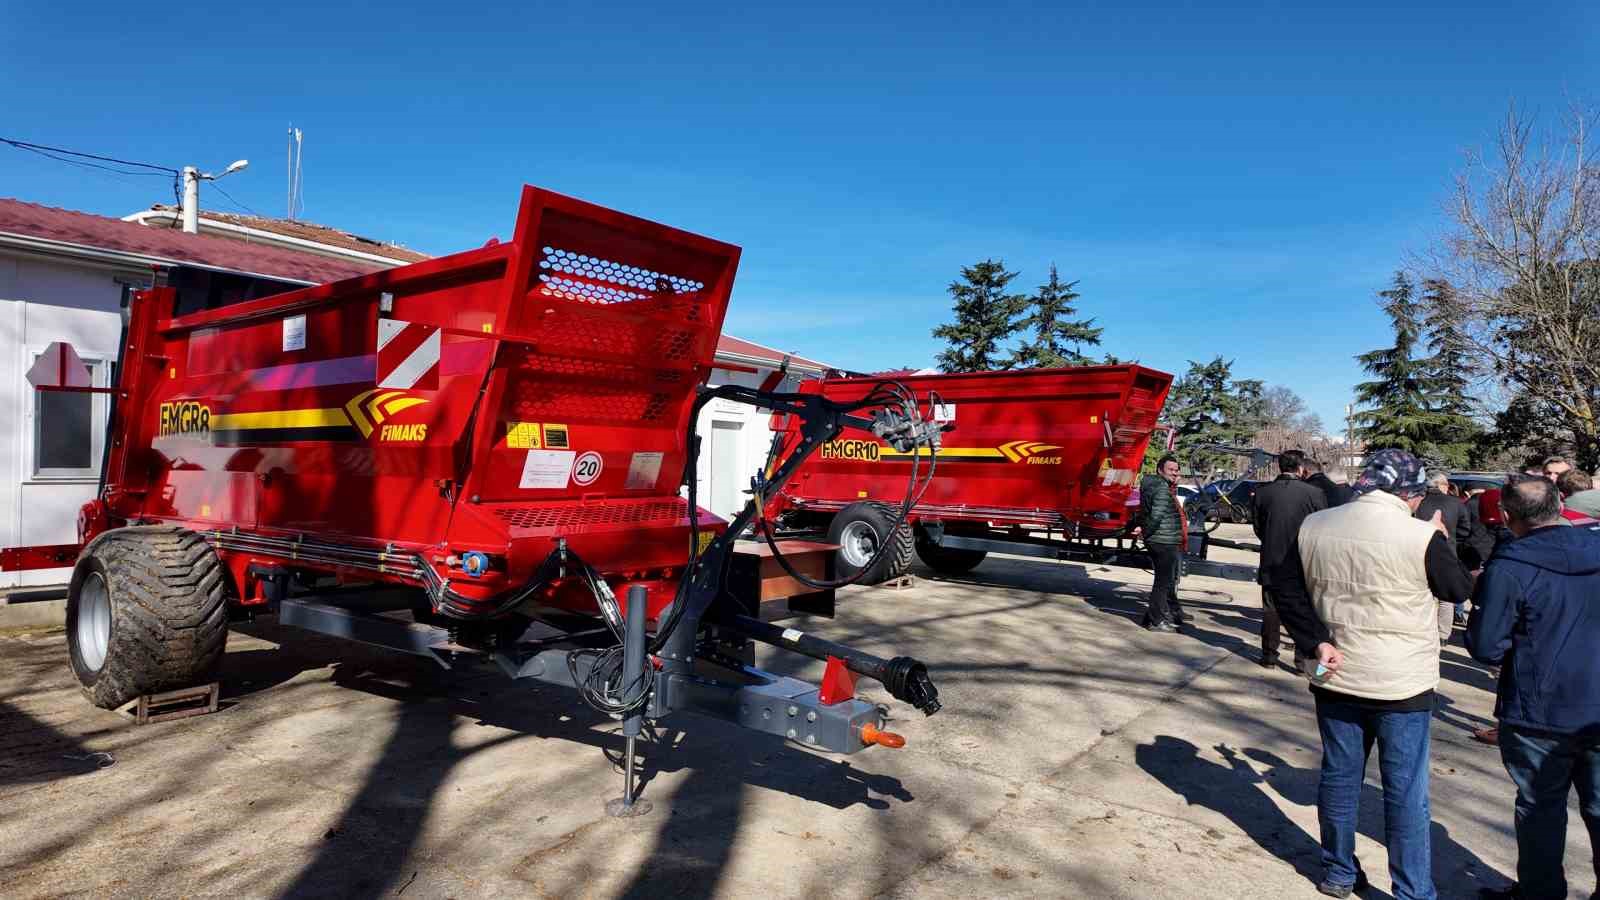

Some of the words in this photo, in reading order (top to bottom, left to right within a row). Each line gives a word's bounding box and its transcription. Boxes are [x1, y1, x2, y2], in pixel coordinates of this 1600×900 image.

[159, 401, 211, 438] FMGR8
[822, 440, 880, 461] FMGR10
[577, 460, 598, 477] 20
